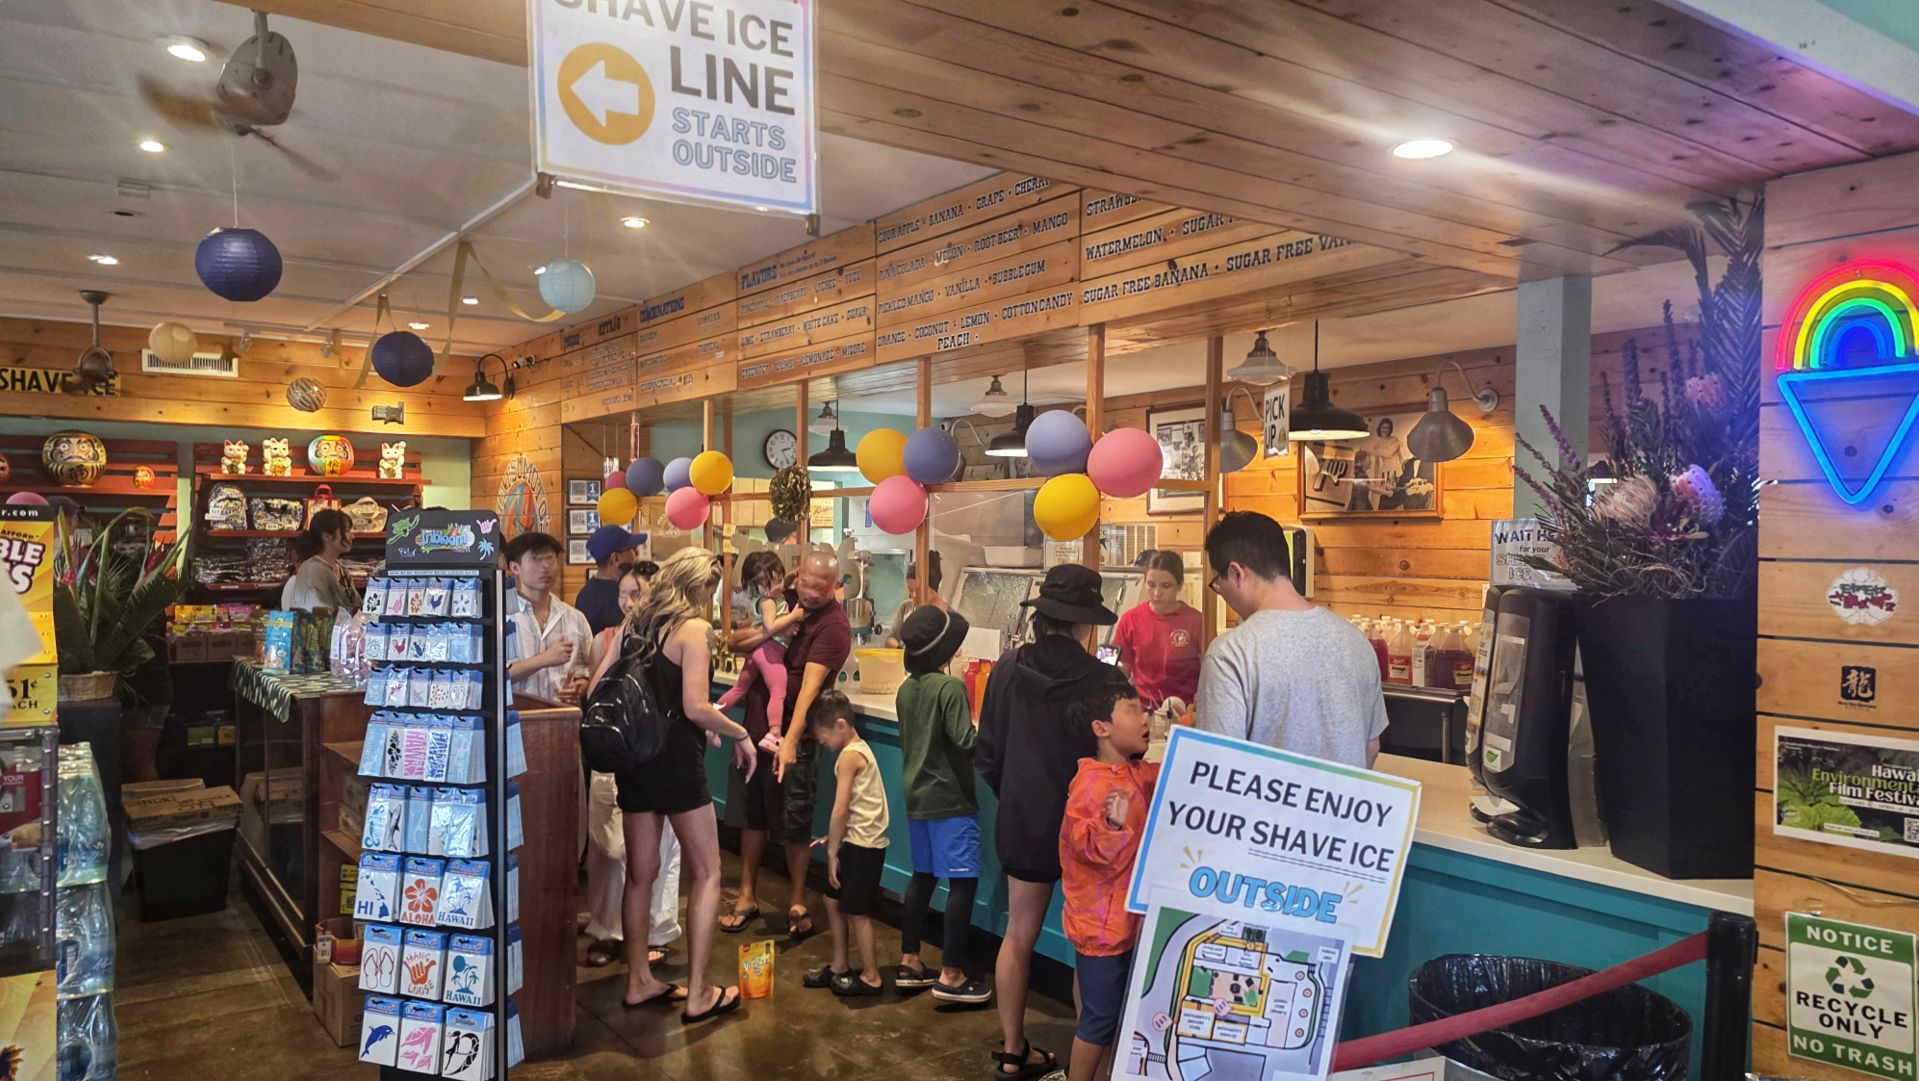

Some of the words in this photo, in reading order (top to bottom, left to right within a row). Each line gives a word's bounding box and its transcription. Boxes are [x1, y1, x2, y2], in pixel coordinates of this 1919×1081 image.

[727, 10, 794, 58] ICE
[670, 46, 795, 115] LINE
[672, 107, 786, 151] STARTS
[673, 140, 797, 183] OUTSIDE
[929, 204, 964, 227] BANANA
[976, 189, 1005, 210] GRAPE
[974, 234, 997, 252] ROOT
[997, 228, 1020, 246] BEER
[1032, 212, 1068, 235] MANGO
[1086, 228, 1163, 261] WATERMELON
[1182, 213, 1225, 236] SUGAR
[741, 265, 777, 290] FLAVORS
[945, 277, 981, 297] VANILLA
[992, 267, 1024, 286] BUBBLE
[1024, 259, 1046, 277] GUM
[1083, 284, 1119, 304] SUGAR
[1123, 276, 1151, 295] FREE
[1154, 262, 1209, 288] BANANA
[1226, 248, 1271, 271] SUGAR
[1276, 238, 1314, 261] FREE
[914, 321, 949, 340] COCONUT
[961, 312, 990, 329] LEMON
[1002, 300, 1039, 320] COTTON
[1039, 292, 1074, 312] CANDY
[937, 331, 971, 351] PEACH
[1265, 394, 1285, 422] PICK
[1265, 426, 1277, 450] UP
[1495, 529, 1533, 544] WAIT
[1520, 545, 1531, 553] for
[1532, 546, 1550, 554] your
[1509, 568, 1532, 581] ICE
[3, 774, 24, 782] YOUR
[1190, 760, 1301, 809] PLEASE
[1305, 787, 1393, 828] ENJOY
[1829, 782, 1862, 798] Film
[1168, 801, 1246, 840] YOUR
[1249, 819, 1346, 863] SHAVE
[1350, 841, 1394, 872] ICE
[357, 900, 374, 916] HI
[1189, 866, 1343, 924] OUTSIDE
[401, 911, 435, 925] ALOHA
[438, 911, 474, 927] HAWAII
[1806, 925, 1894, 955] NOTICE
[445, 989, 481, 1006] HAWAII
[1796, 990, 1908, 1029] RECYCLE
[1818, 1013, 1884, 1040] ONLY
[1793, 1034, 1824, 1054] NO
[1831, 1043, 1913, 1076] TRASH
